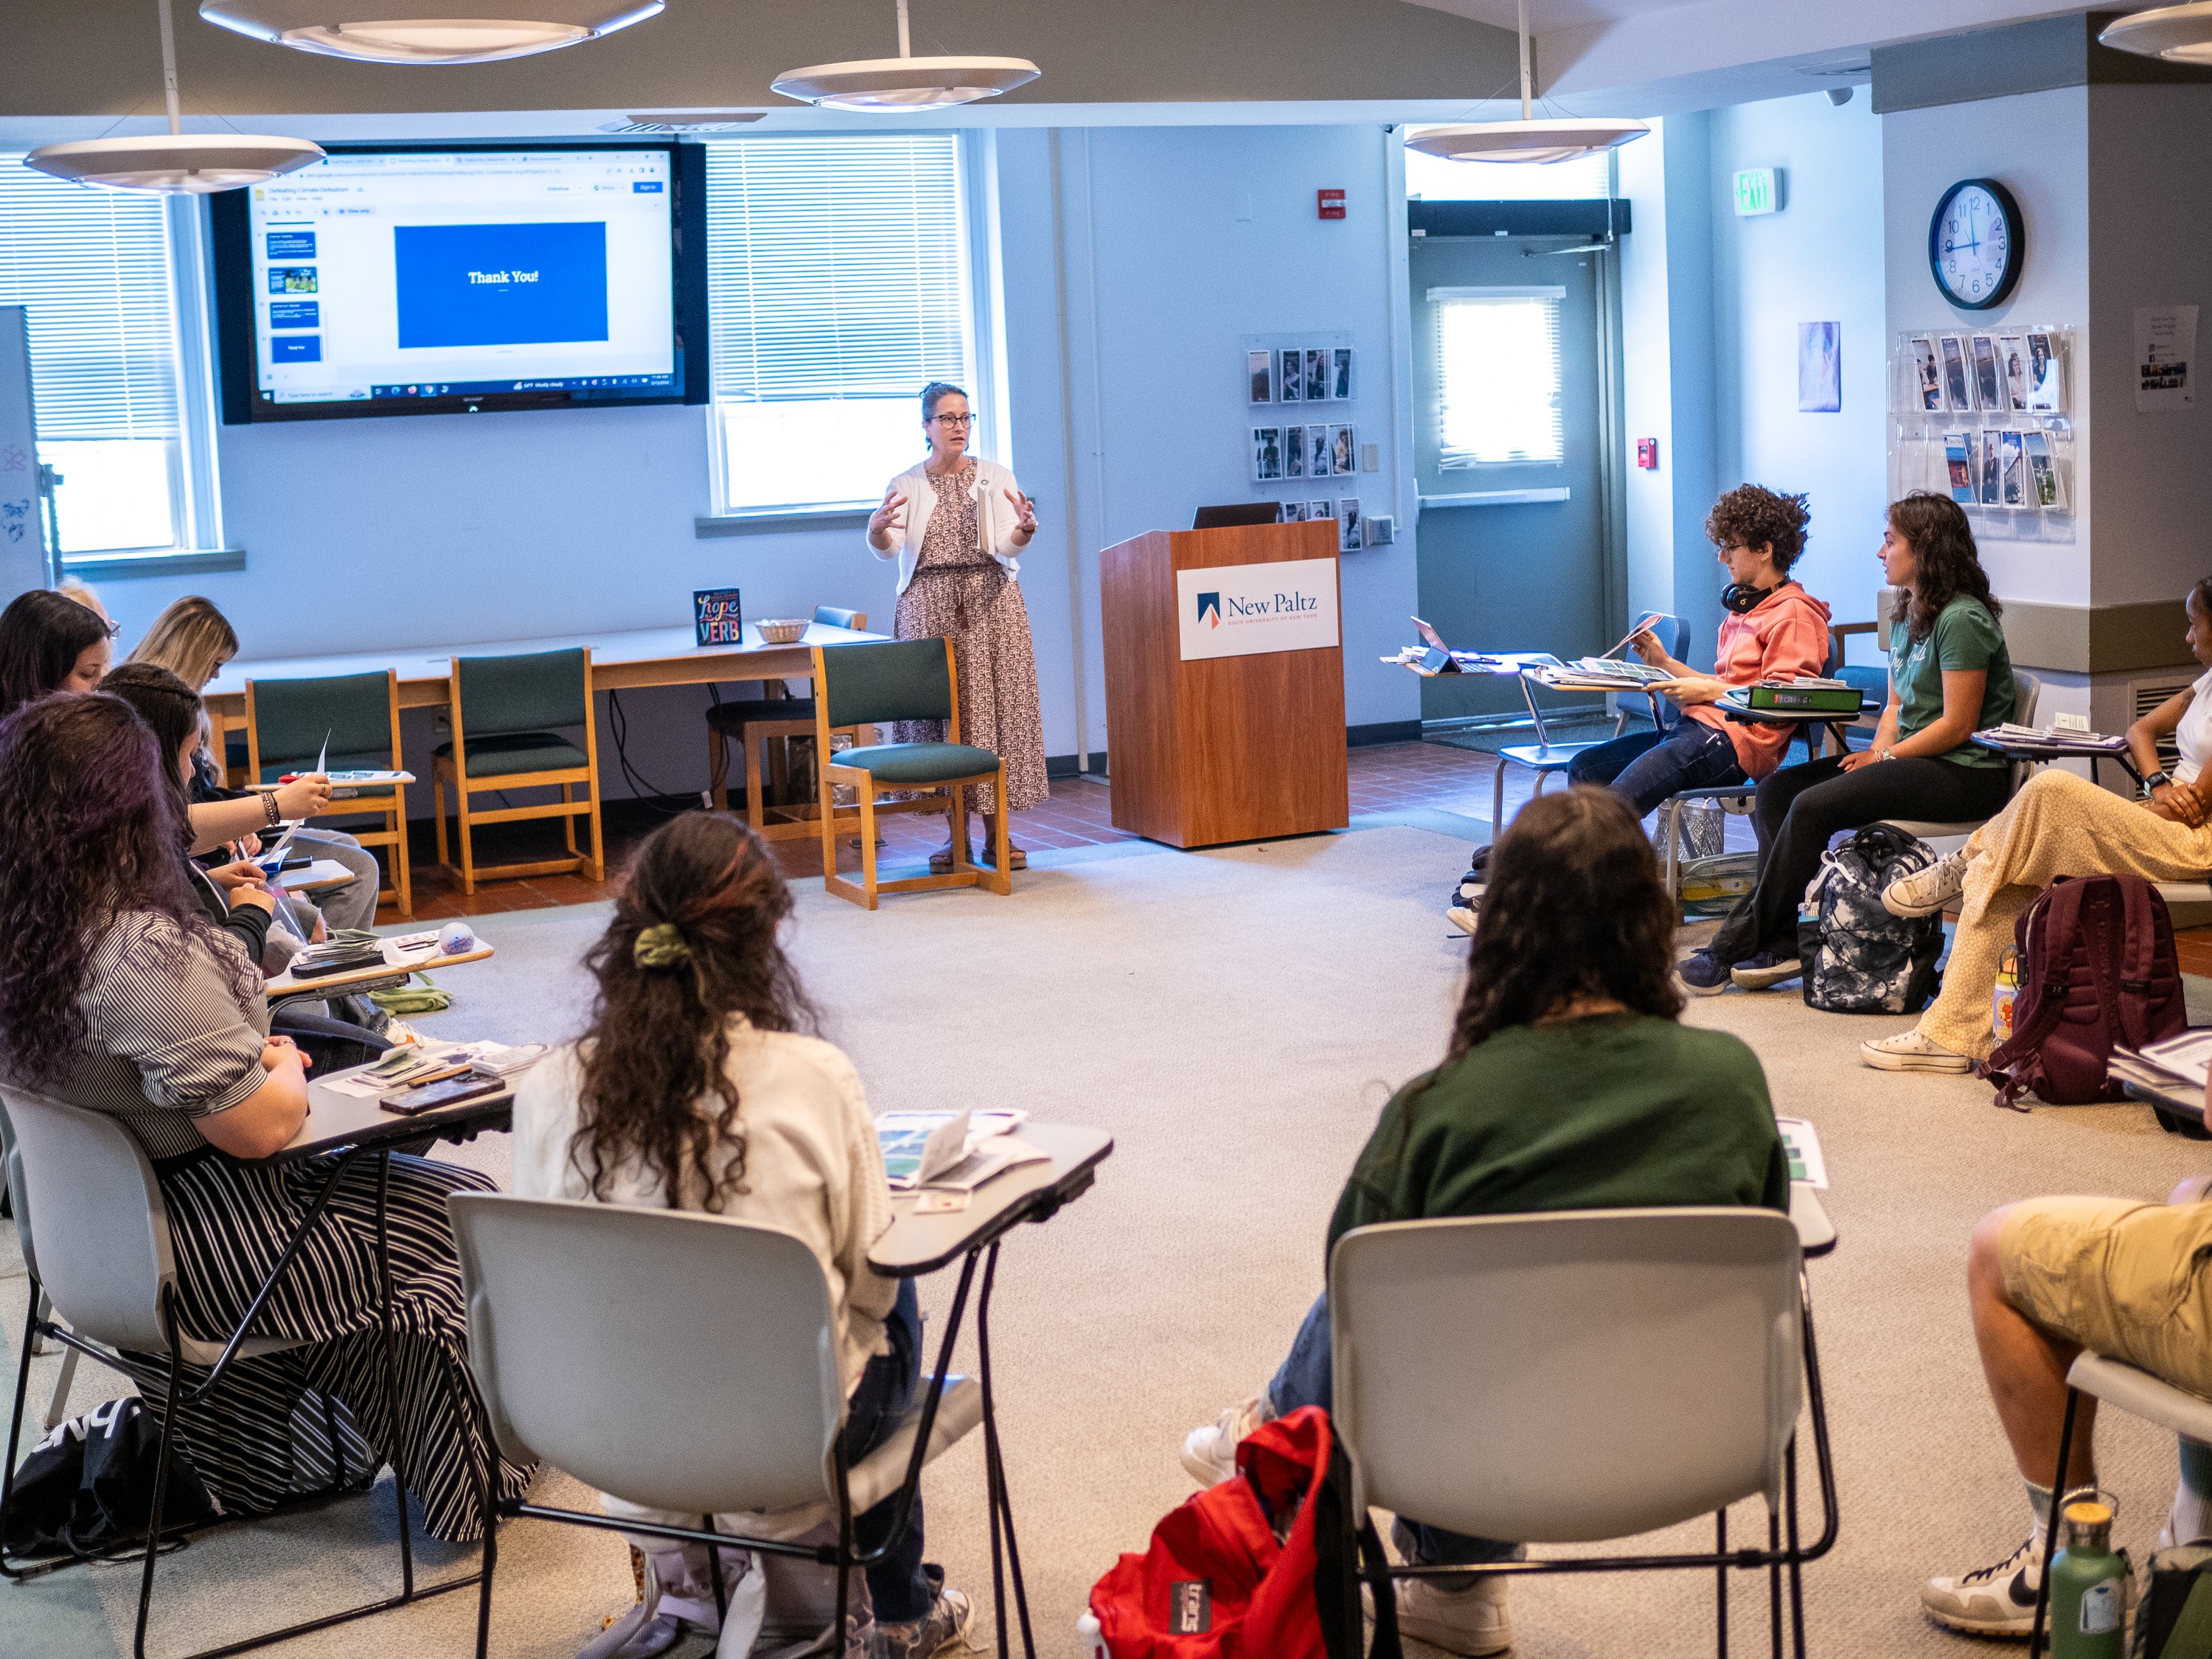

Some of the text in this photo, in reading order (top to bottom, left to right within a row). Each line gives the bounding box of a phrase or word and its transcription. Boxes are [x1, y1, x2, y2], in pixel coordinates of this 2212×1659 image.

[1739, 171, 1768, 210] EXIT
[1948, 220, 1959, 234] 10
[1994, 217, 2002, 231] 2
[1998, 236, 2006, 250] 3
[1950, 260, 1957, 273] 8
[1994, 257, 2003, 271] 4
[468, 270, 539, 284] Thank You!
[1959, 274, 1966, 288] 7
[1986, 273, 1993, 287] 5
[1972, 279, 1980, 293] 6
[698, 595, 738, 621] hope
[1227, 591, 1318, 617] New Paltz
[700, 620, 740, 641] VERB
